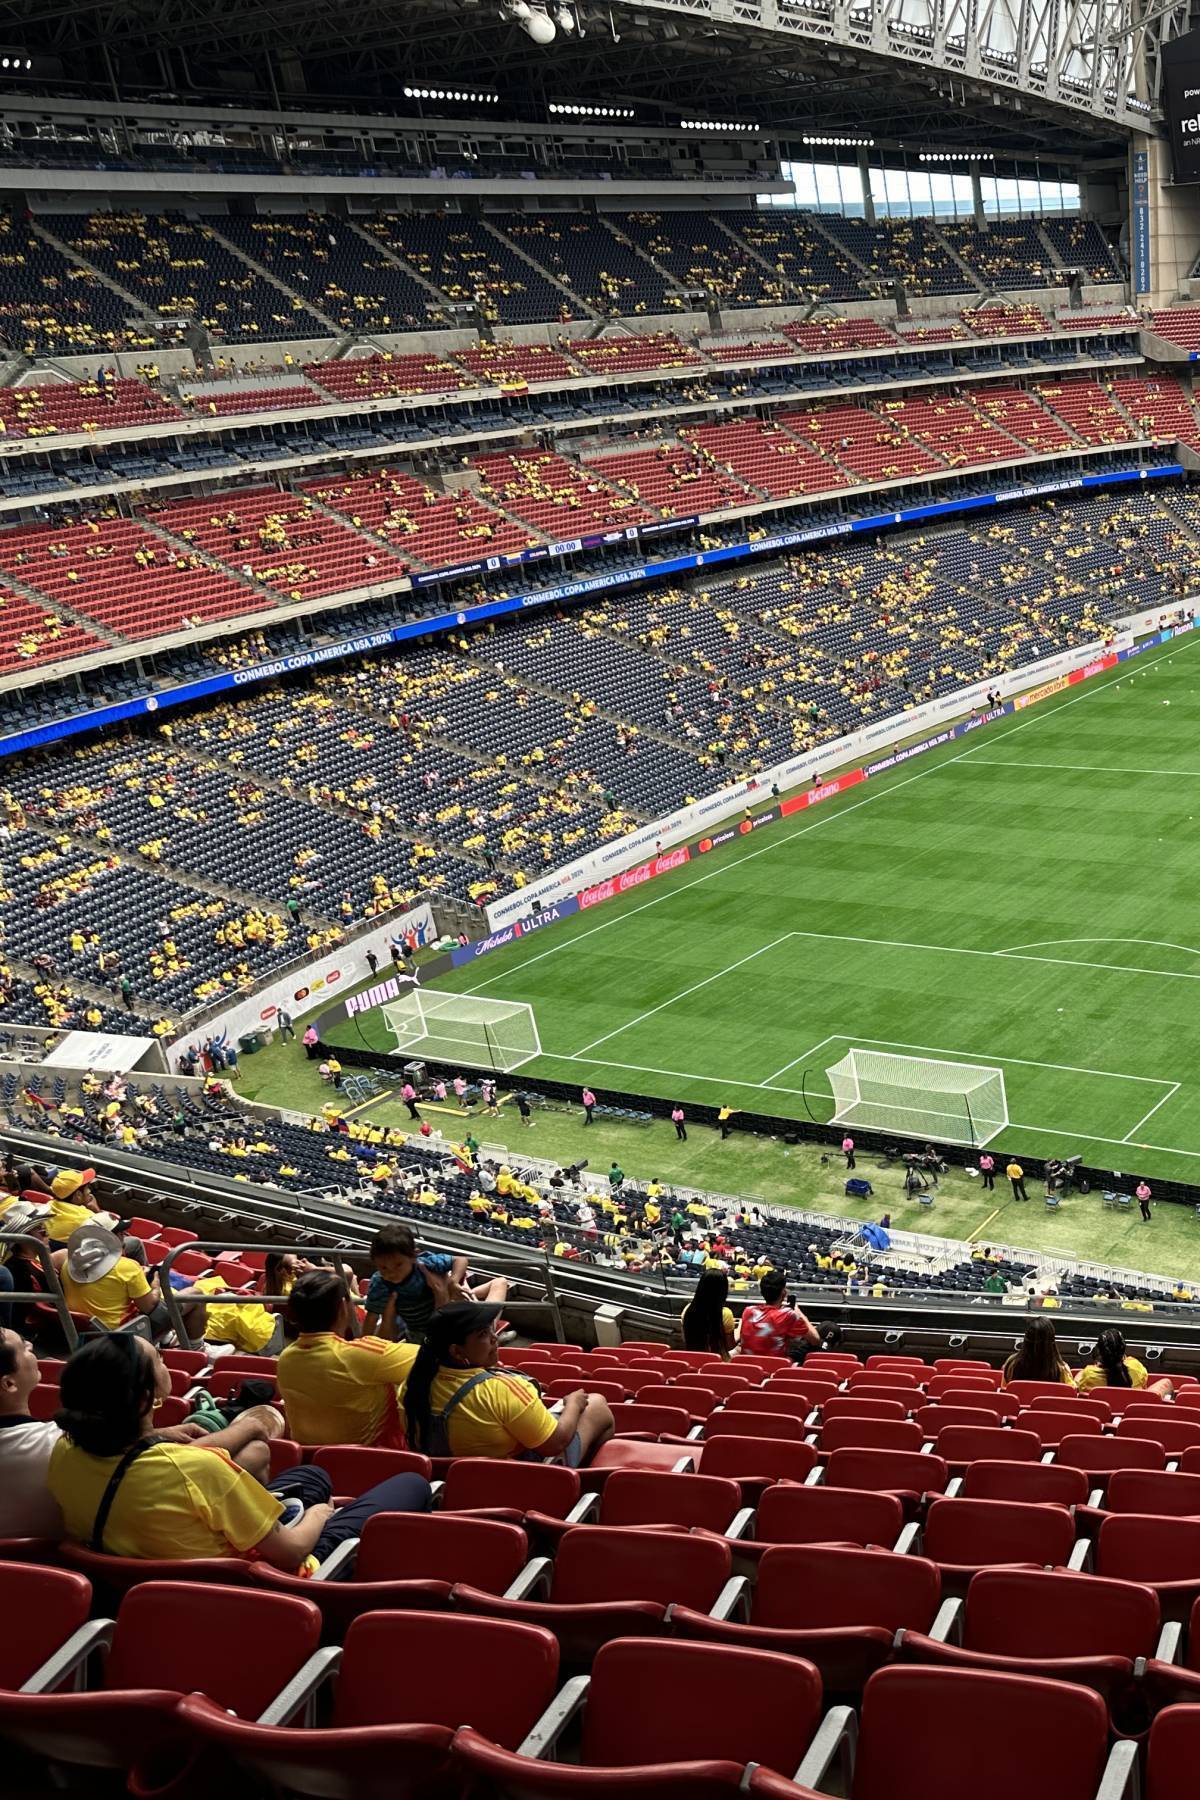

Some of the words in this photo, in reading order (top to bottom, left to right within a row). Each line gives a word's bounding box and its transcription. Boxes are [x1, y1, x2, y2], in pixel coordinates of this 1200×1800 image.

[750, 539, 784, 552] CONMEBOL
[784, 535, 801, 545] COPA
[800, 530, 826, 542] AMERICA
[827, 527, 838, 535] USA
[837, 524, 853, 533] 2024
[523, 588, 564, 606] CONMEBOL
[564, 583, 586, 597] COPA
[584, 576, 615, 592] AMERICA
[616, 572, 630, 583] USA
[629, 569, 646, 580] 2024
[233, 660, 288, 684] CONMEBOL
[288, 655, 315, 670] COPA
[314, 645, 354, 663] AMERICA
[354, 639, 372, 651] USA
[372, 633, 392, 646] 2024
[986, 707, 1005, 721] ULTRA
[808, 781, 839, 805] Betano
[494, 900, 524, 919] CONMEBOL
[524, 892, 538, 904] COPA
[537, 881, 560, 896] AMERICA
[560, 876, 571, 884] USA
[571, 869, 583, 879] 2024
[521, 909, 560, 933] ULTRA
[345, 978, 400, 1018] PUMA
